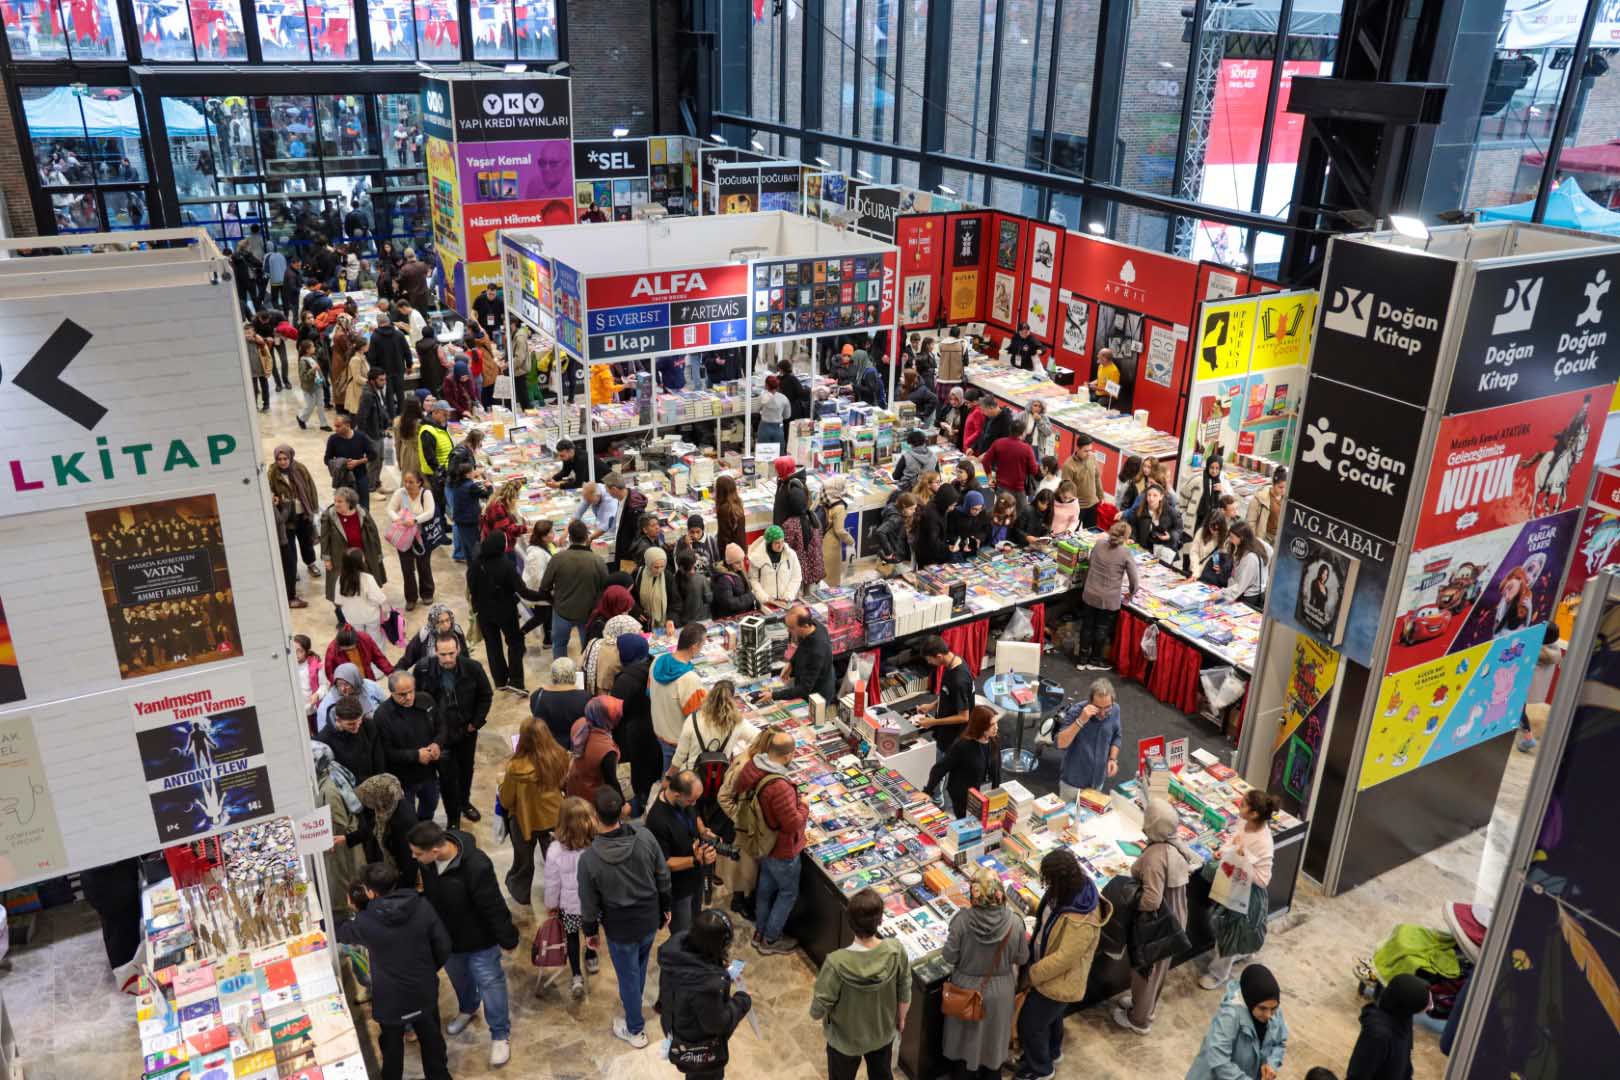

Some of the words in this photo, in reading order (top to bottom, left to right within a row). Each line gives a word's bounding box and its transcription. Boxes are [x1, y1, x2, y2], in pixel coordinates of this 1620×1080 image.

[485, 95, 541, 112] YKY
[460, 119, 482, 129] YAPI
[485, 116, 516, 129] KREDİ
[518, 115, 569, 128] YAYINLARI
[466, 156, 497, 169] Yaşar
[498, 153, 532, 166] Kemal
[720, 176, 759, 190] DOĞUBATI
[761, 172, 800, 188] DOĞUBATI
[470, 215, 502, 228] Nâzım
[631, 272, 708, 298] ALFA
[882, 266, 893, 312] ALFA
[609, 310, 661, 327] EVEREST
[690, 300, 739, 321] ARTEMİS
[1377, 302, 1438, 331] Doğan
[620, 334, 655, 352] kapı
[1374, 325, 1422, 355] Kitap
[1557, 330, 1607, 354] Doğan
[1485, 343, 1534, 366] Doğan
[1554, 351, 1599, 382] Çocuk
[1478, 370, 1519, 392] Kitap
[1341, 436, 1405, 475] Doğan
[1338, 460, 1395, 495] Çocuk
[1435, 454, 1520, 515] NUTUK
[1292, 508, 1323, 535] N.G.
[1326, 522, 1384, 562] KABAL
[1528, 526, 1557, 544] KARLAR
[143, 563, 184, 578] VATAN
[137, 589, 164, 601] AHMET
[166, 584, 199, 597] ANAPALI
[134, 689, 212, 716] Yanılmışım
[173, 705, 203, 720] Tanrı
[204, 695, 246, 712] Varmış
[163, 768, 212, 789] ANTONY
[216, 759, 248, 777] FLEW
